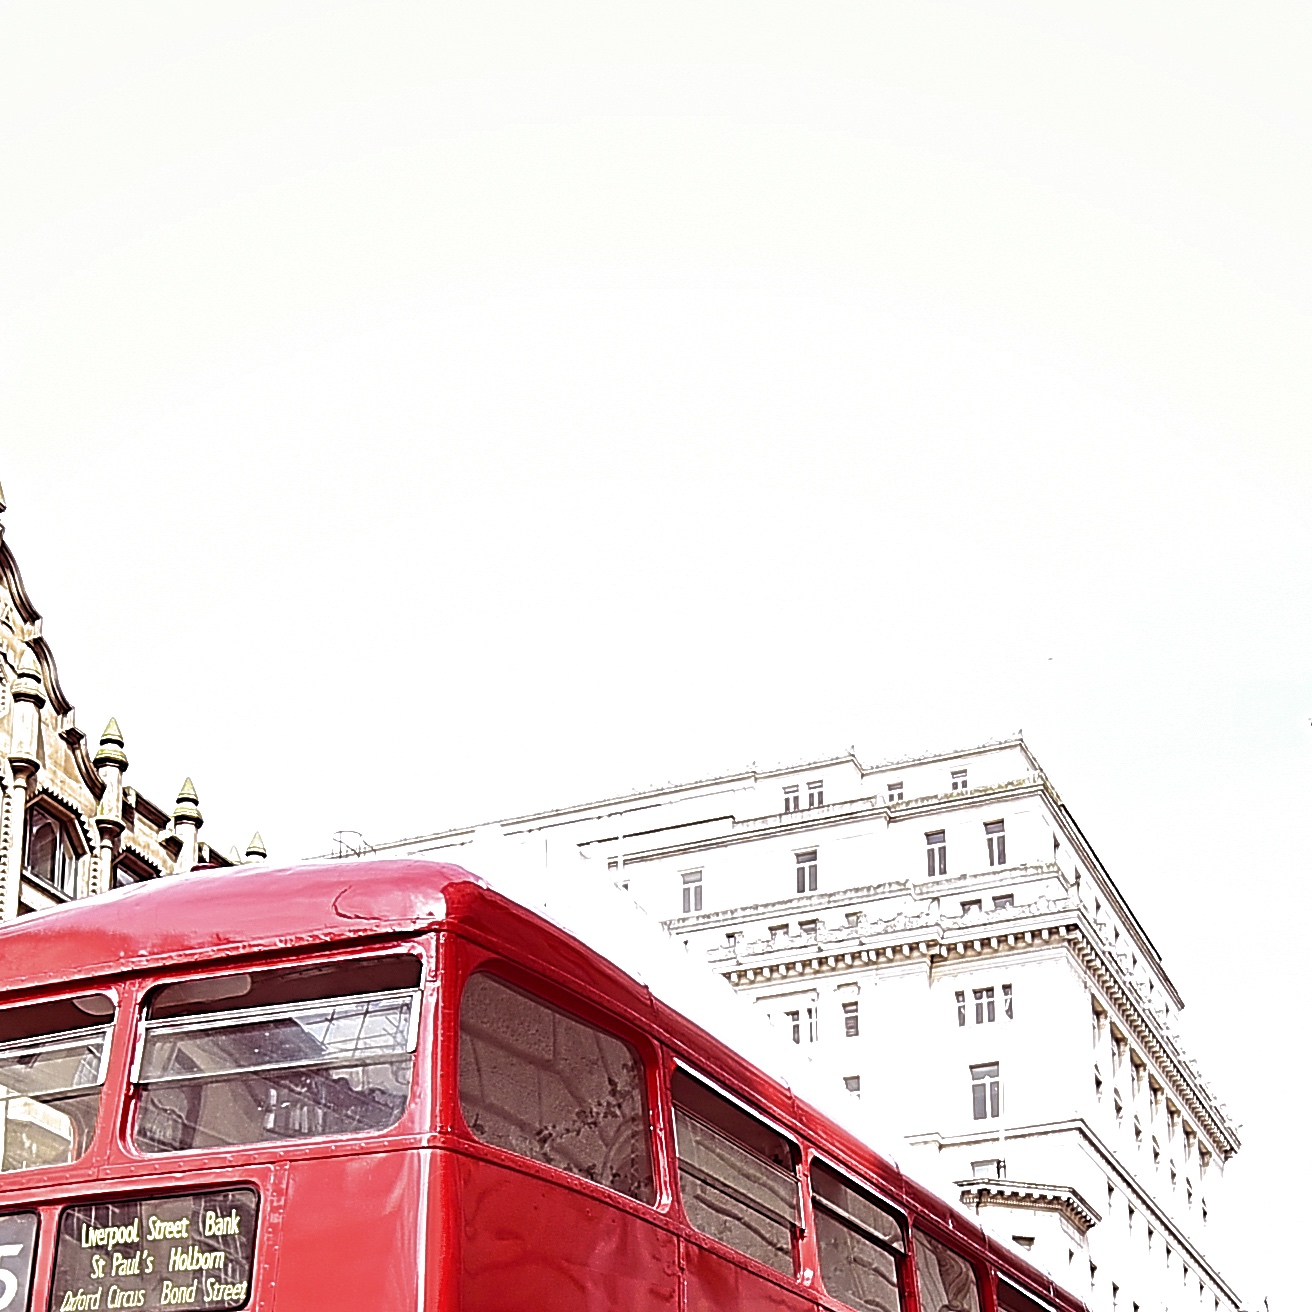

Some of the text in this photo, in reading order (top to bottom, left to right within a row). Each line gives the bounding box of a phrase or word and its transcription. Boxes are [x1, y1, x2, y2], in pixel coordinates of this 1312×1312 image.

[81, 1209, 241, 1250] Liverpool Street Bank
[90, 1255, 106, 1280] St
[111, 1249, 154, 1277] Paul's
[59, 1278, 248, 1312] Oxford Circus Bond Street
